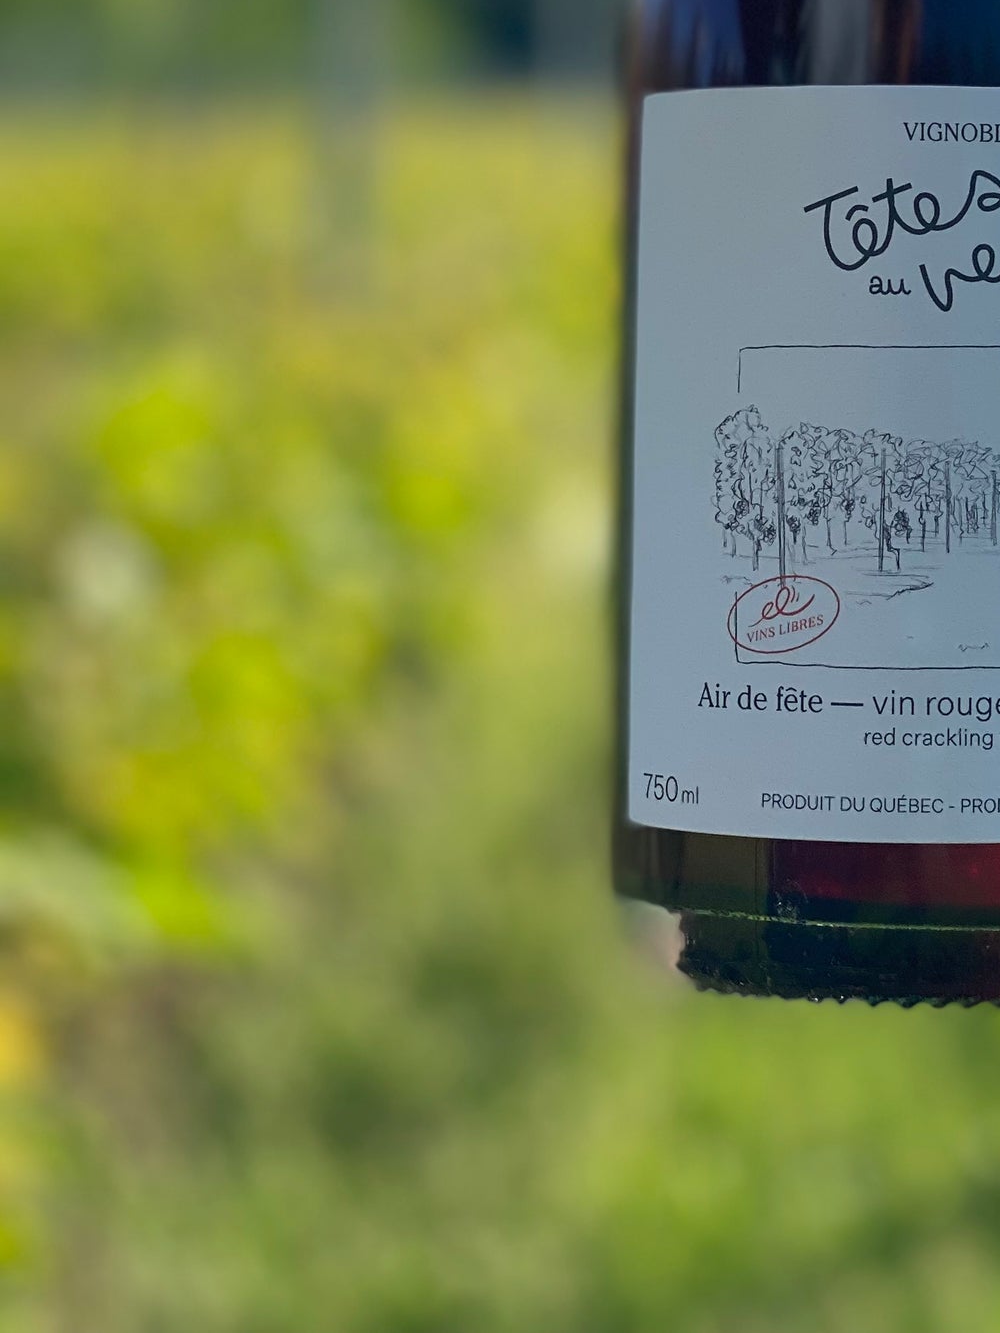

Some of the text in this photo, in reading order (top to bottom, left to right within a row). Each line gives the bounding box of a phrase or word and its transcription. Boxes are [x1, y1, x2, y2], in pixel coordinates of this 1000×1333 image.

[868, 273, 912, 297] au
[745, 614, 825, 643] VINS LIBRES
[697, 681, 731, 709] Air
[737, 684, 767, 711] de
[775, 685, 823, 713] fête
[872, 689, 915, 716] vin
[863, 727, 896, 746] red
[901, 727, 994, 750] crackling
[760, 792, 836, 812] PRODUIT
[839, 796, 866, 812] DU
[869, 794, 944, 814] QUÉBEC
